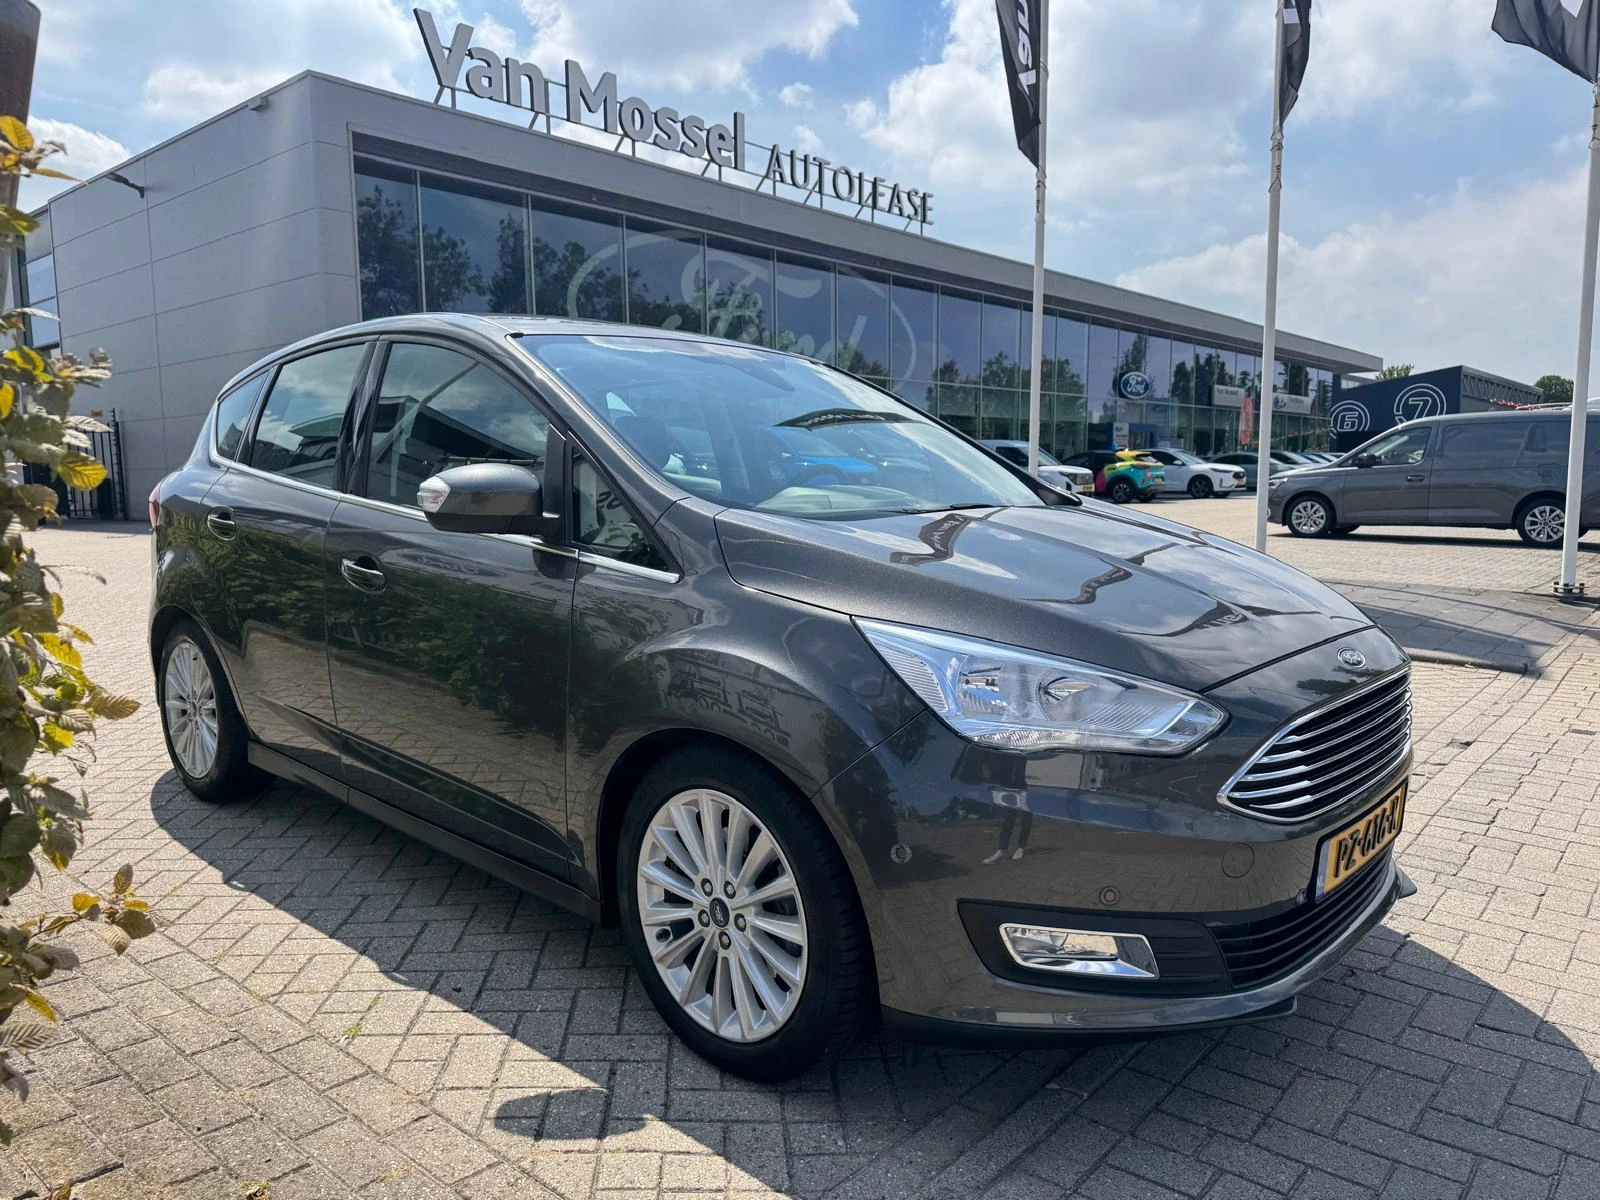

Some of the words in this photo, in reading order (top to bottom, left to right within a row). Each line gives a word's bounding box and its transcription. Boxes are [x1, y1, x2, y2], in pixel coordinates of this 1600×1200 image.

[413, 8, 546, 114] Van
[565, 59, 745, 170] Mossel
[765, 143, 935, 226] AUTOLEASE
[1126, 375, 1146, 393] Ford
[1408, 396, 1432, 420] 7
[1336, 411, 1359, 432] 6
